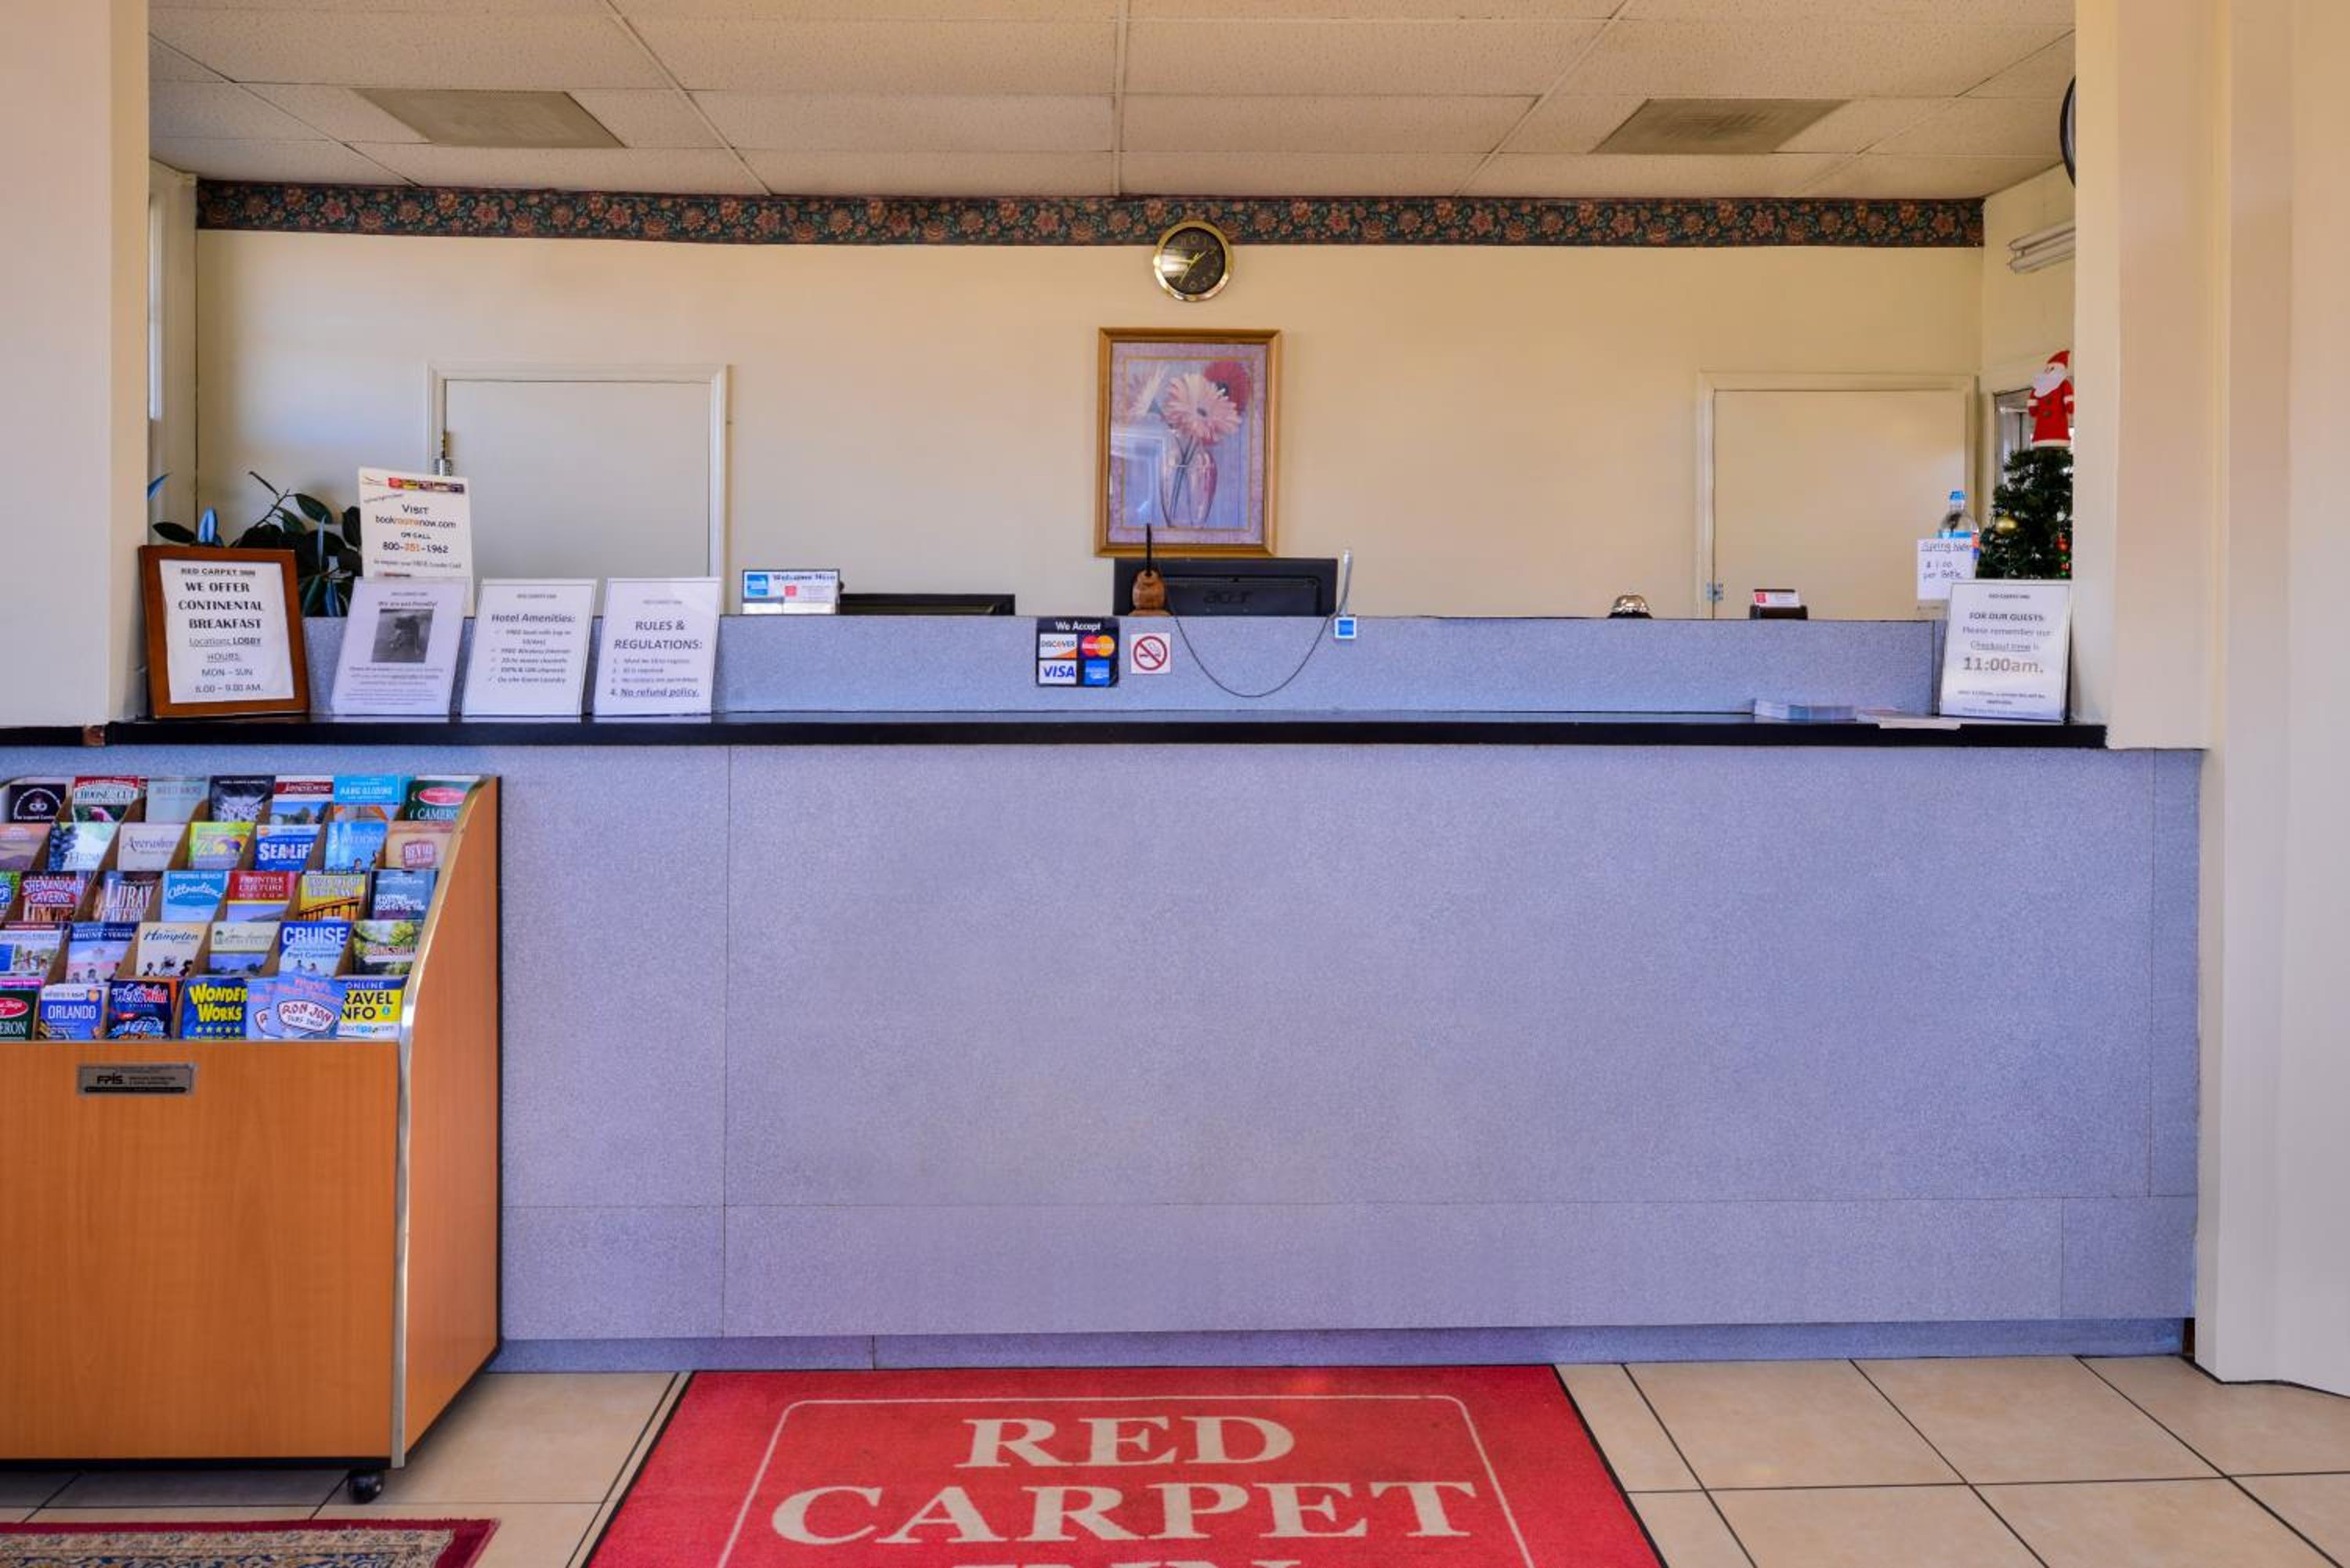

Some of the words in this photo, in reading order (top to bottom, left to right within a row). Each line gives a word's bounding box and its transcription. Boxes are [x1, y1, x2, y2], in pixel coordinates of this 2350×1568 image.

[201, 568, 237, 576] CARPET
[186, 582, 204, 592] WE
[209, 582, 251, 593] OFFER
[178, 600, 264, 611] CONTINENTAL
[492, 613, 519, 623] Hotel
[521, 613, 577, 624] Amenities:
[1969, 612, 1985, 620] FOR
[189, 618, 262, 630] BREAKFAST
[635, 620, 673, 631] RULES
[676, 620, 685, 631] &
[1056, 622, 1071, 630] We
[1072, 621, 1101, 632] Accept
[233, 637, 262, 646] LOBBY
[614, 639, 703, 650] REGULATIONS:
[1041, 639, 1076, 649] DISCOVER
[1962, 657, 2044, 674] 11:00am.
[201, 669, 226, 677] MON
[235, 668, 254, 677] SUN
[1043, 666, 1076, 677] VISA
[620, 688, 634, 697] No
[636, 688, 667, 697] refund
[258, 843, 289, 861] SEA
[143, 928, 199, 942] Hampton
[283, 927, 347, 945] CRUISE
[344, 992, 393, 1005] RAVEL
[48, 1005, 96, 1019] ORLANDO
[197, 1003, 243, 1022] WORKS
[282, 1005, 308, 1014] RON
[309, 1007, 332, 1023] JON
[340, 1007, 376, 1020] NFO
[953, 1415, 1296, 1468] RED
[772, 1482, 1477, 1545] CARPET
